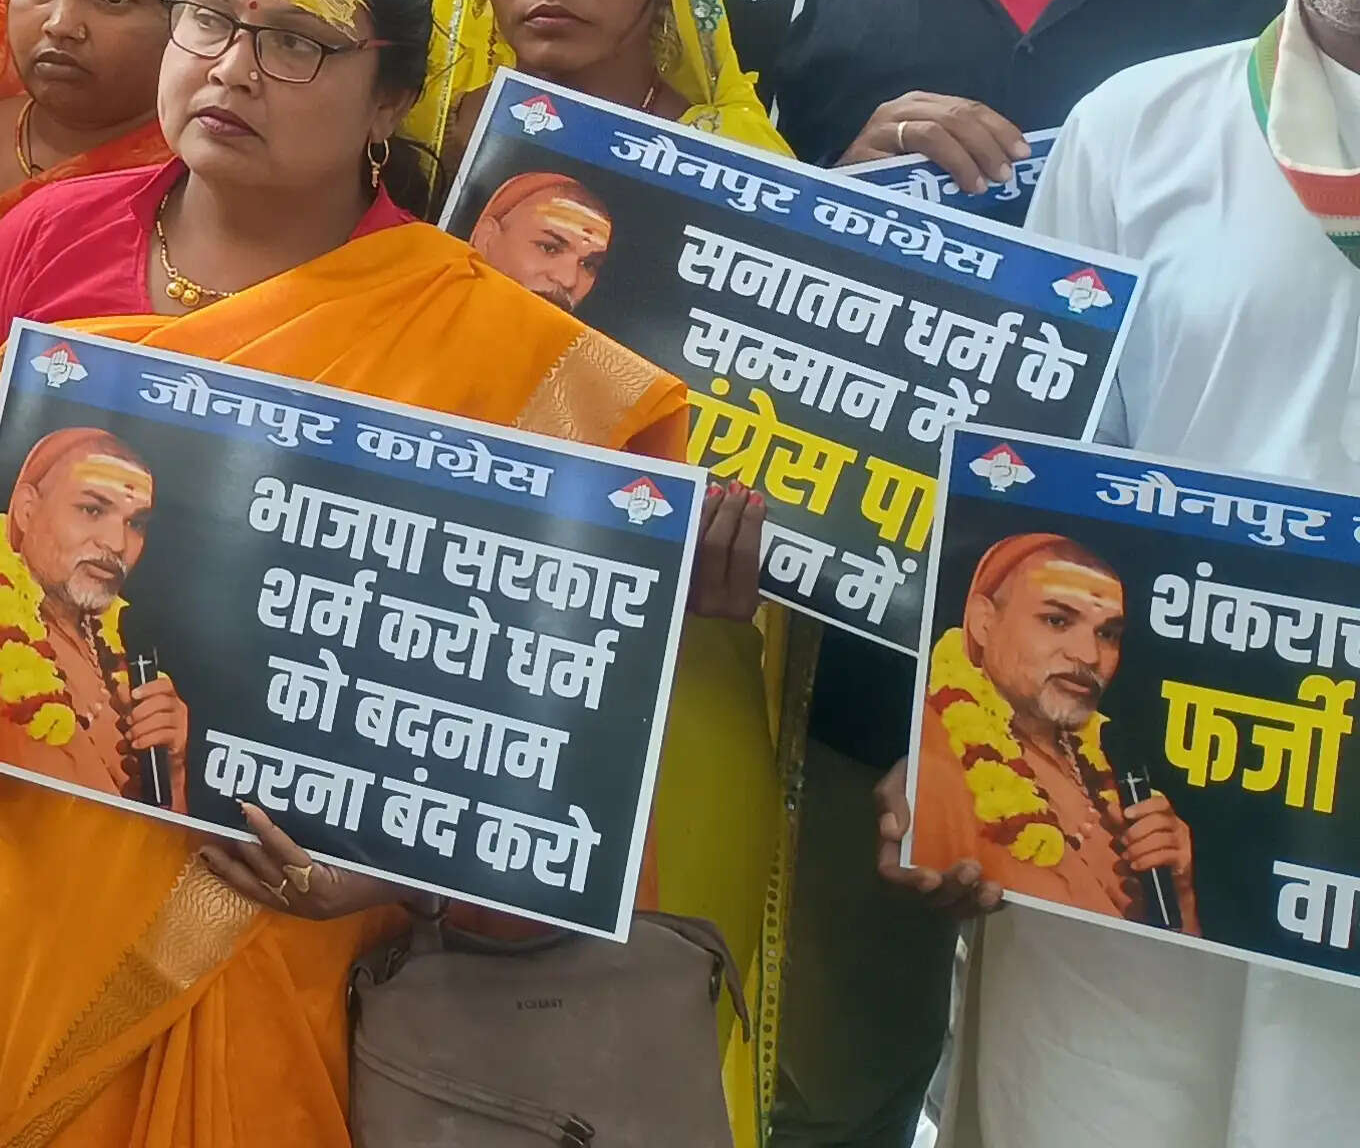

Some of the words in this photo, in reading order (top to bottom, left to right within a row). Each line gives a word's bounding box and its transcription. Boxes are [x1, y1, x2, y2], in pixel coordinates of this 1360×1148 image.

[609, 129, 801, 215] जौनपुर
[812, 196, 1003, 281] कांग्रेस
[676, 224, 903, 350] सनातन
[904, 299, 1019, 386] धर्म
[1015, 322, 1087, 402] के
[682, 307, 908, 433] सम्मान
[907, 378, 993, 450] में
[139, 372, 340, 447] जौनपुर
[355, 422, 555, 499] कांग्रेस
[686, 378, 858, 516] ांग्रेस
[860, 456, 939, 553] पा
[248, 476, 437, 576] भाजपा
[440, 521, 659, 629] सरकार
[1096, 470, 1331, 546] जौनपुर
[256, 566, 377, 652] शर्म
[377, 595, 498, 682] करो
[506, 628, 620, 710] धर्म
[834, 546, 919, 626] में
[266, 650, 351, 733] को
[354, 682, 569, 792] बदनाम
[1161, 674, 1357, 814] फर्जी
[203, 729, 394, 832] करना
[379, 766, 470, 859] बंद
[476, 804, 601, 894] करो
[1272, 859, 1360, 949] वा
